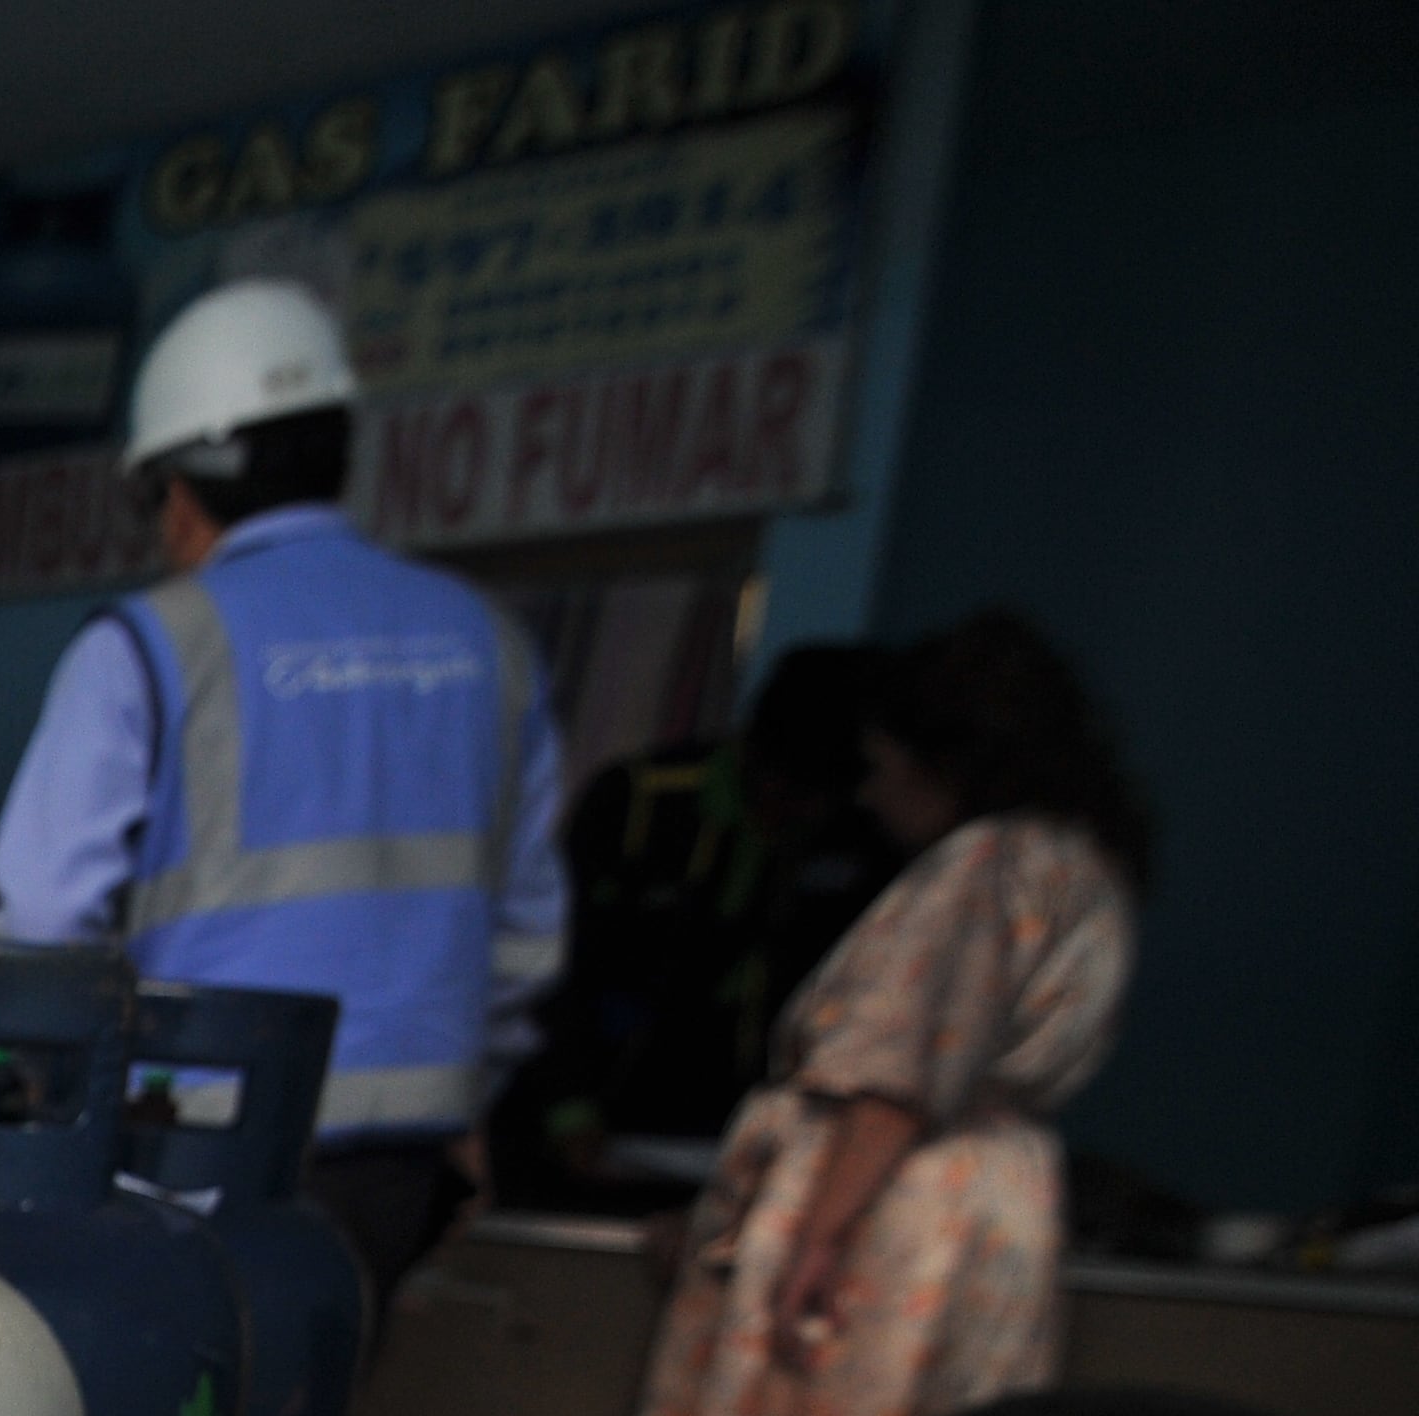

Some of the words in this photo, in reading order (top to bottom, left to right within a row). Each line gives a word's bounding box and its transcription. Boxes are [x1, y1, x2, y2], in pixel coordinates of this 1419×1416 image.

[153, 100, 374, 231] GAS
[429, 2, 850, 174] FARID
[371, 402, 485, 532] NO
[507, 352, 815, 520] FUMAR
